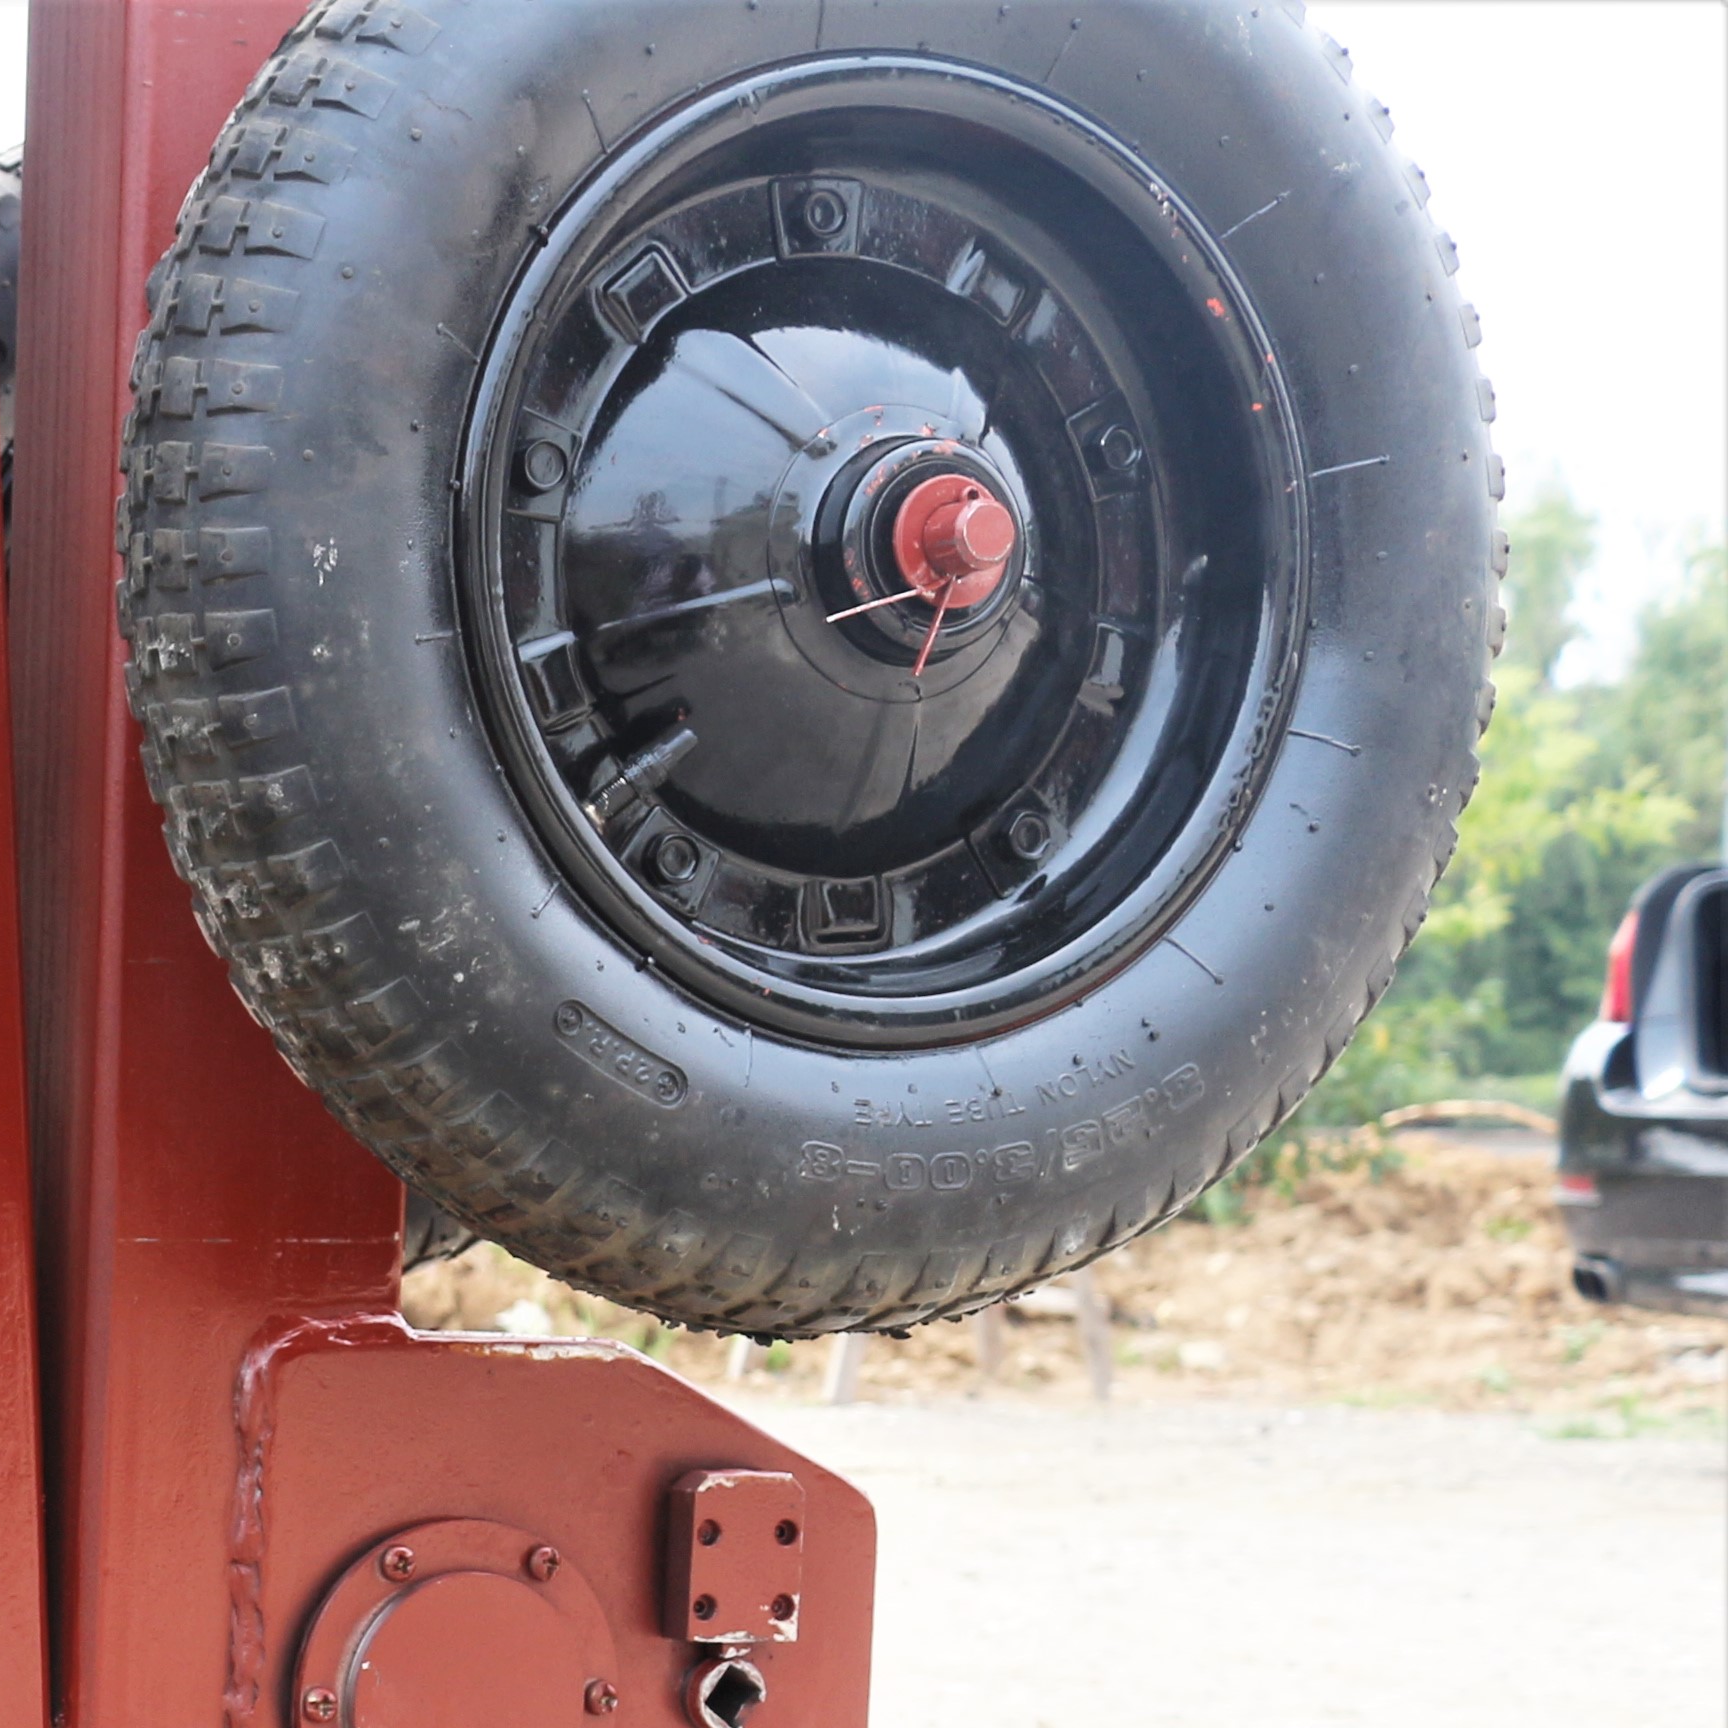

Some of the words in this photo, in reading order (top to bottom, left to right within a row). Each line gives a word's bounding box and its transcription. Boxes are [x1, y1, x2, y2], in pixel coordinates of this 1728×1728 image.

[1034, 1048, 1136, 1108] NYLON
[854, 1099, 932, 1127] TYPE
[946, 1092, 1026, 1124] TUBE
